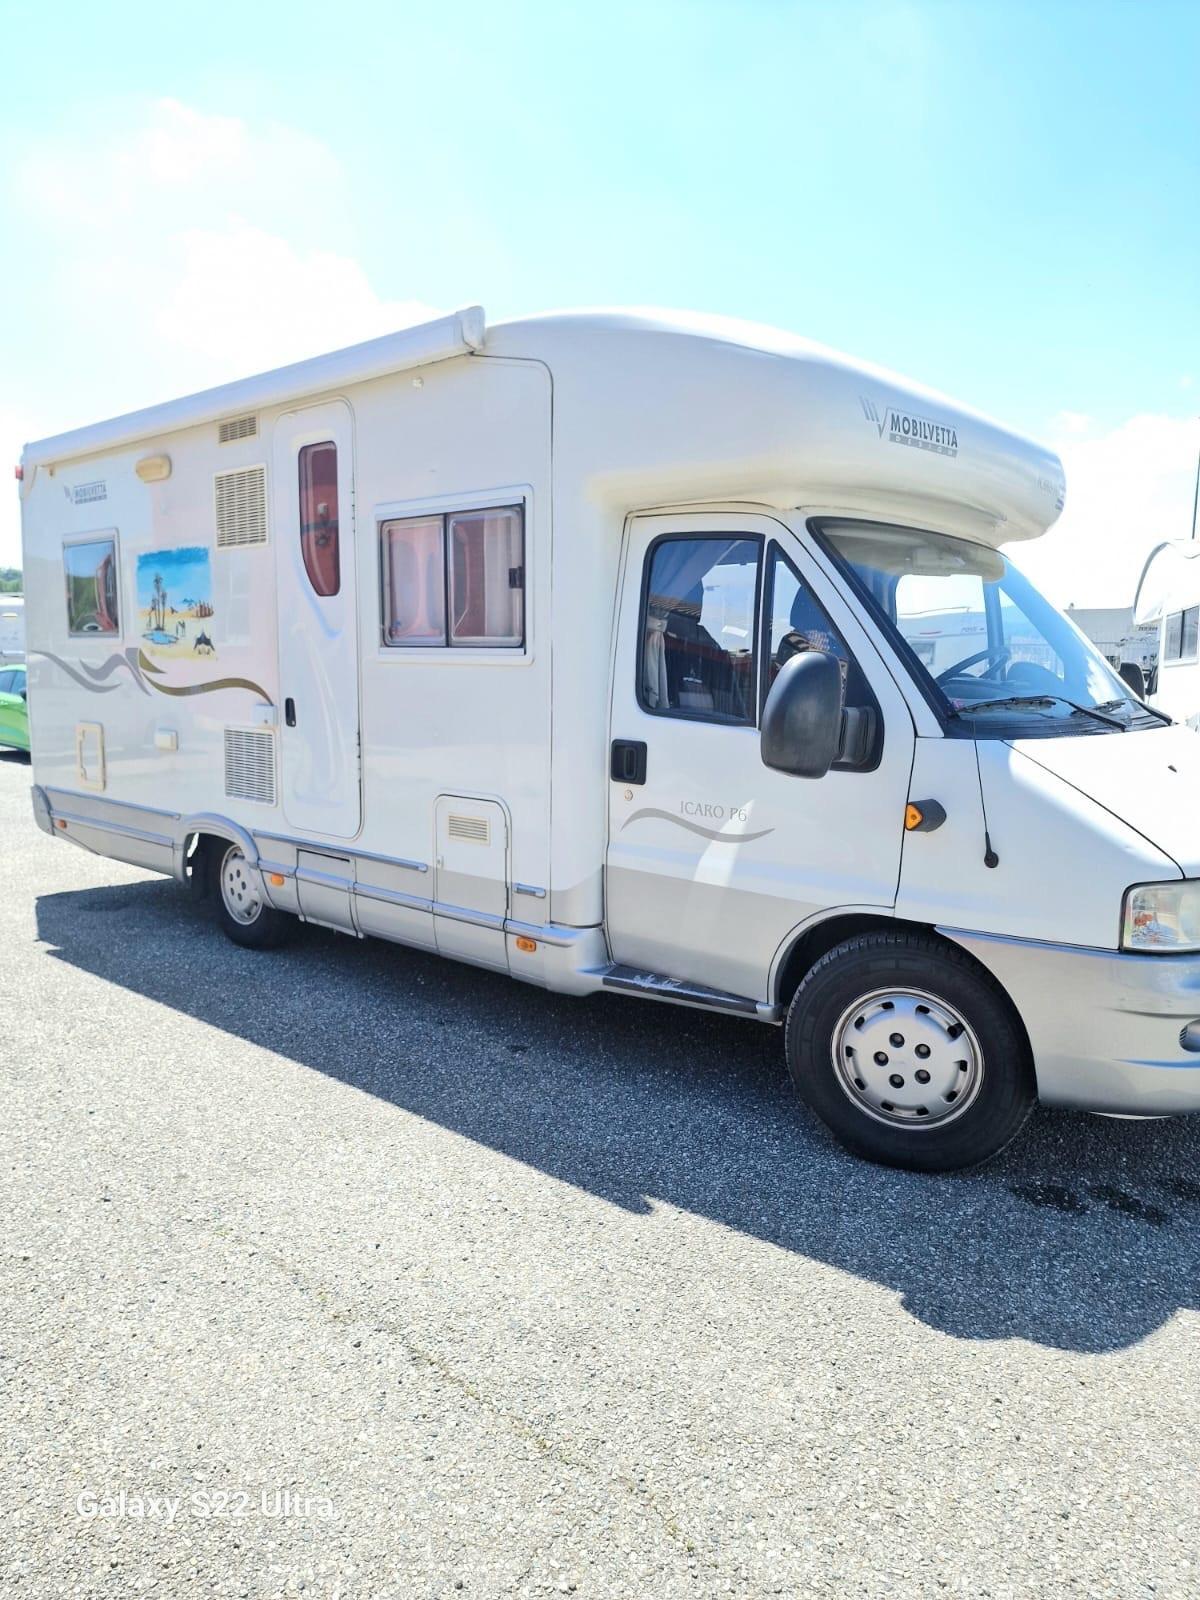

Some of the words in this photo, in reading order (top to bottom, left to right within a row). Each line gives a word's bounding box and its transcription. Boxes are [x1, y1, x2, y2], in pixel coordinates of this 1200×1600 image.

[890, 412, 958, 449] MOBILVETTA
[679, 800, 725, 819] ICARO
[729, 807, 747, 821] P6
